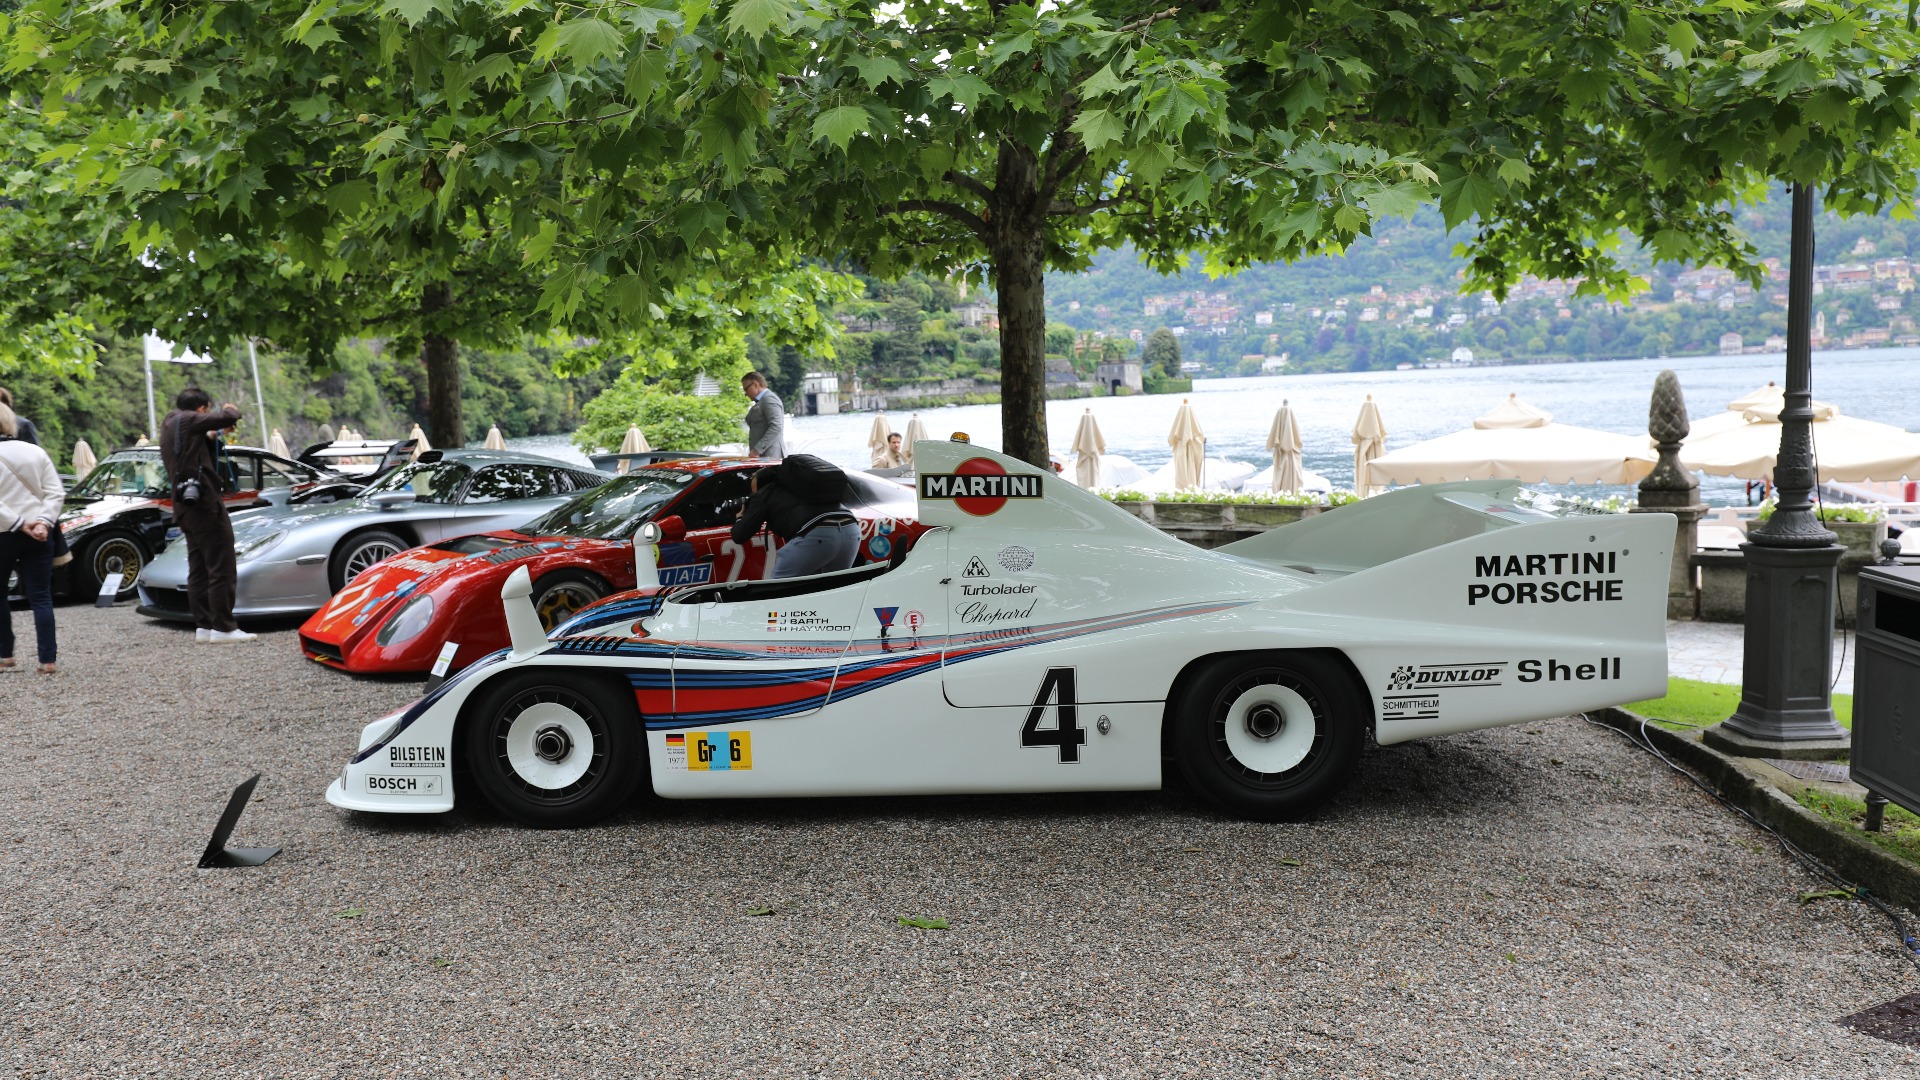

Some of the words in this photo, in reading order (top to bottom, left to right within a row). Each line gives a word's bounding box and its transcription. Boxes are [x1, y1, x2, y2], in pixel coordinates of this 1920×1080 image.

[926, 476, 1037, 497] MARTINI
[1475, 551, 1616, 578] MARTINI
[960, 583, 1038, 596] Turbolader
[1468, 579, 1624, 606] PORSCHE
[955, 598, 1038, 625] Chopard
[1415, 668, 1500, 684] DUNLOP
[1517, 657, 1621, 683] Shell
[1019, 665, 1087, 764] 4
[1382, 699, 1440, 710] SCHMITTHELM
[390, 746, 445, 761] BILSTEIN
[697, 739, 717, 762] Gr
[729, 738, 741, 762] 6
[369, 776, 417, 790] BOSCH
